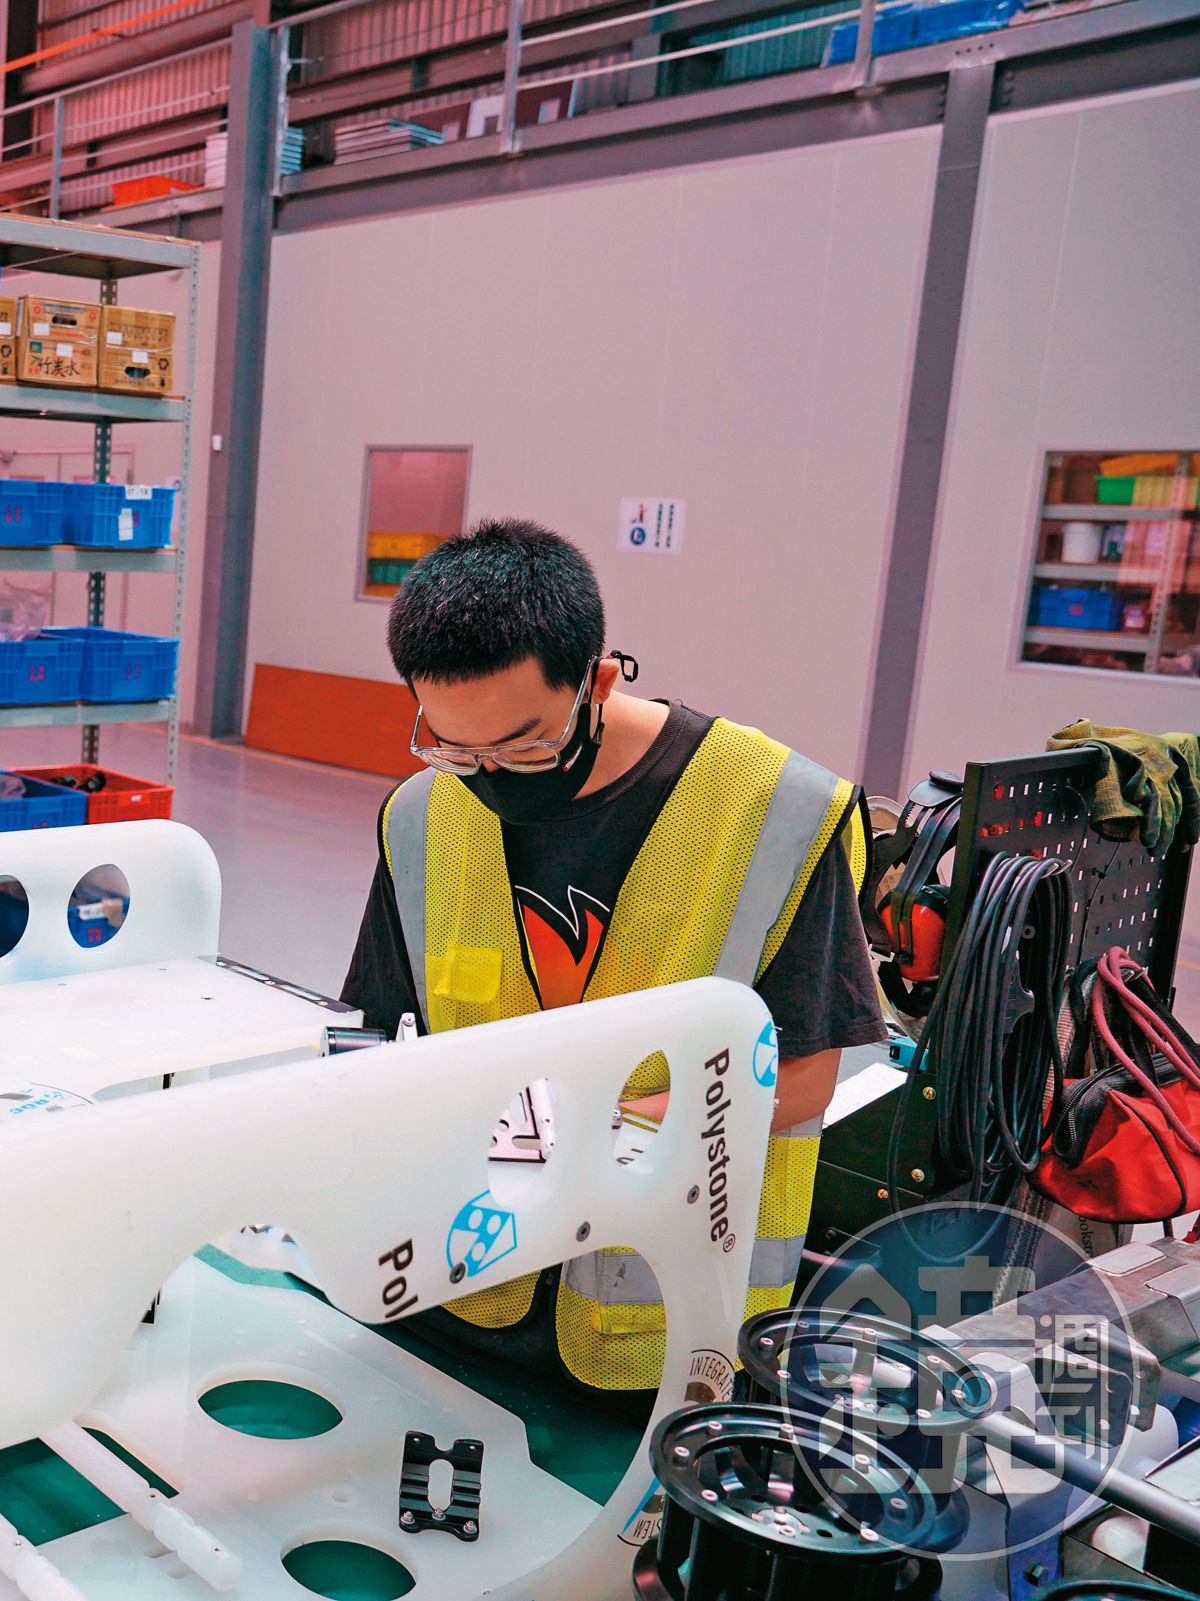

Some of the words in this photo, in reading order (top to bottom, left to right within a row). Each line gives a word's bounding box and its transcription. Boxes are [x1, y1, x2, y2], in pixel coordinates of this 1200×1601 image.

[30, 356, 80, 378] 竹炭水
[378, 1237, 418, 1318] Pol
